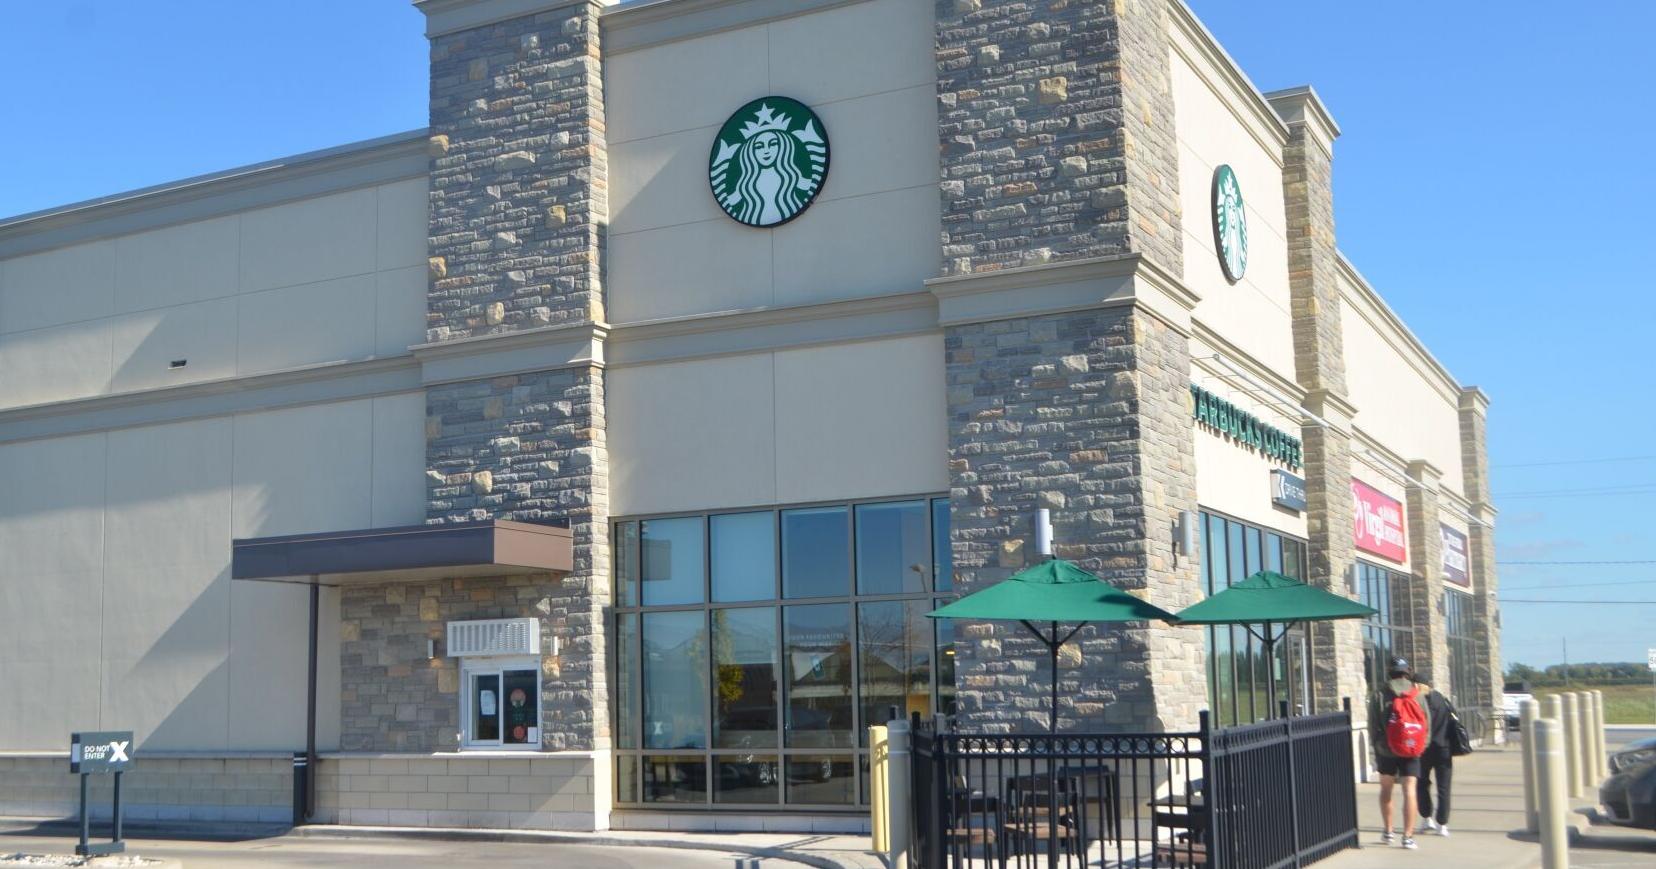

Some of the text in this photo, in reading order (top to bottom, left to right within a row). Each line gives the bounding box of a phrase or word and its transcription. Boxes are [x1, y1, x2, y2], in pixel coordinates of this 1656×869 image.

[1190, 383, 1264, 450] TARBUCKS
[84, 744, 110, 753] DO NOT
[84, 752, 105, 760] ENTER
